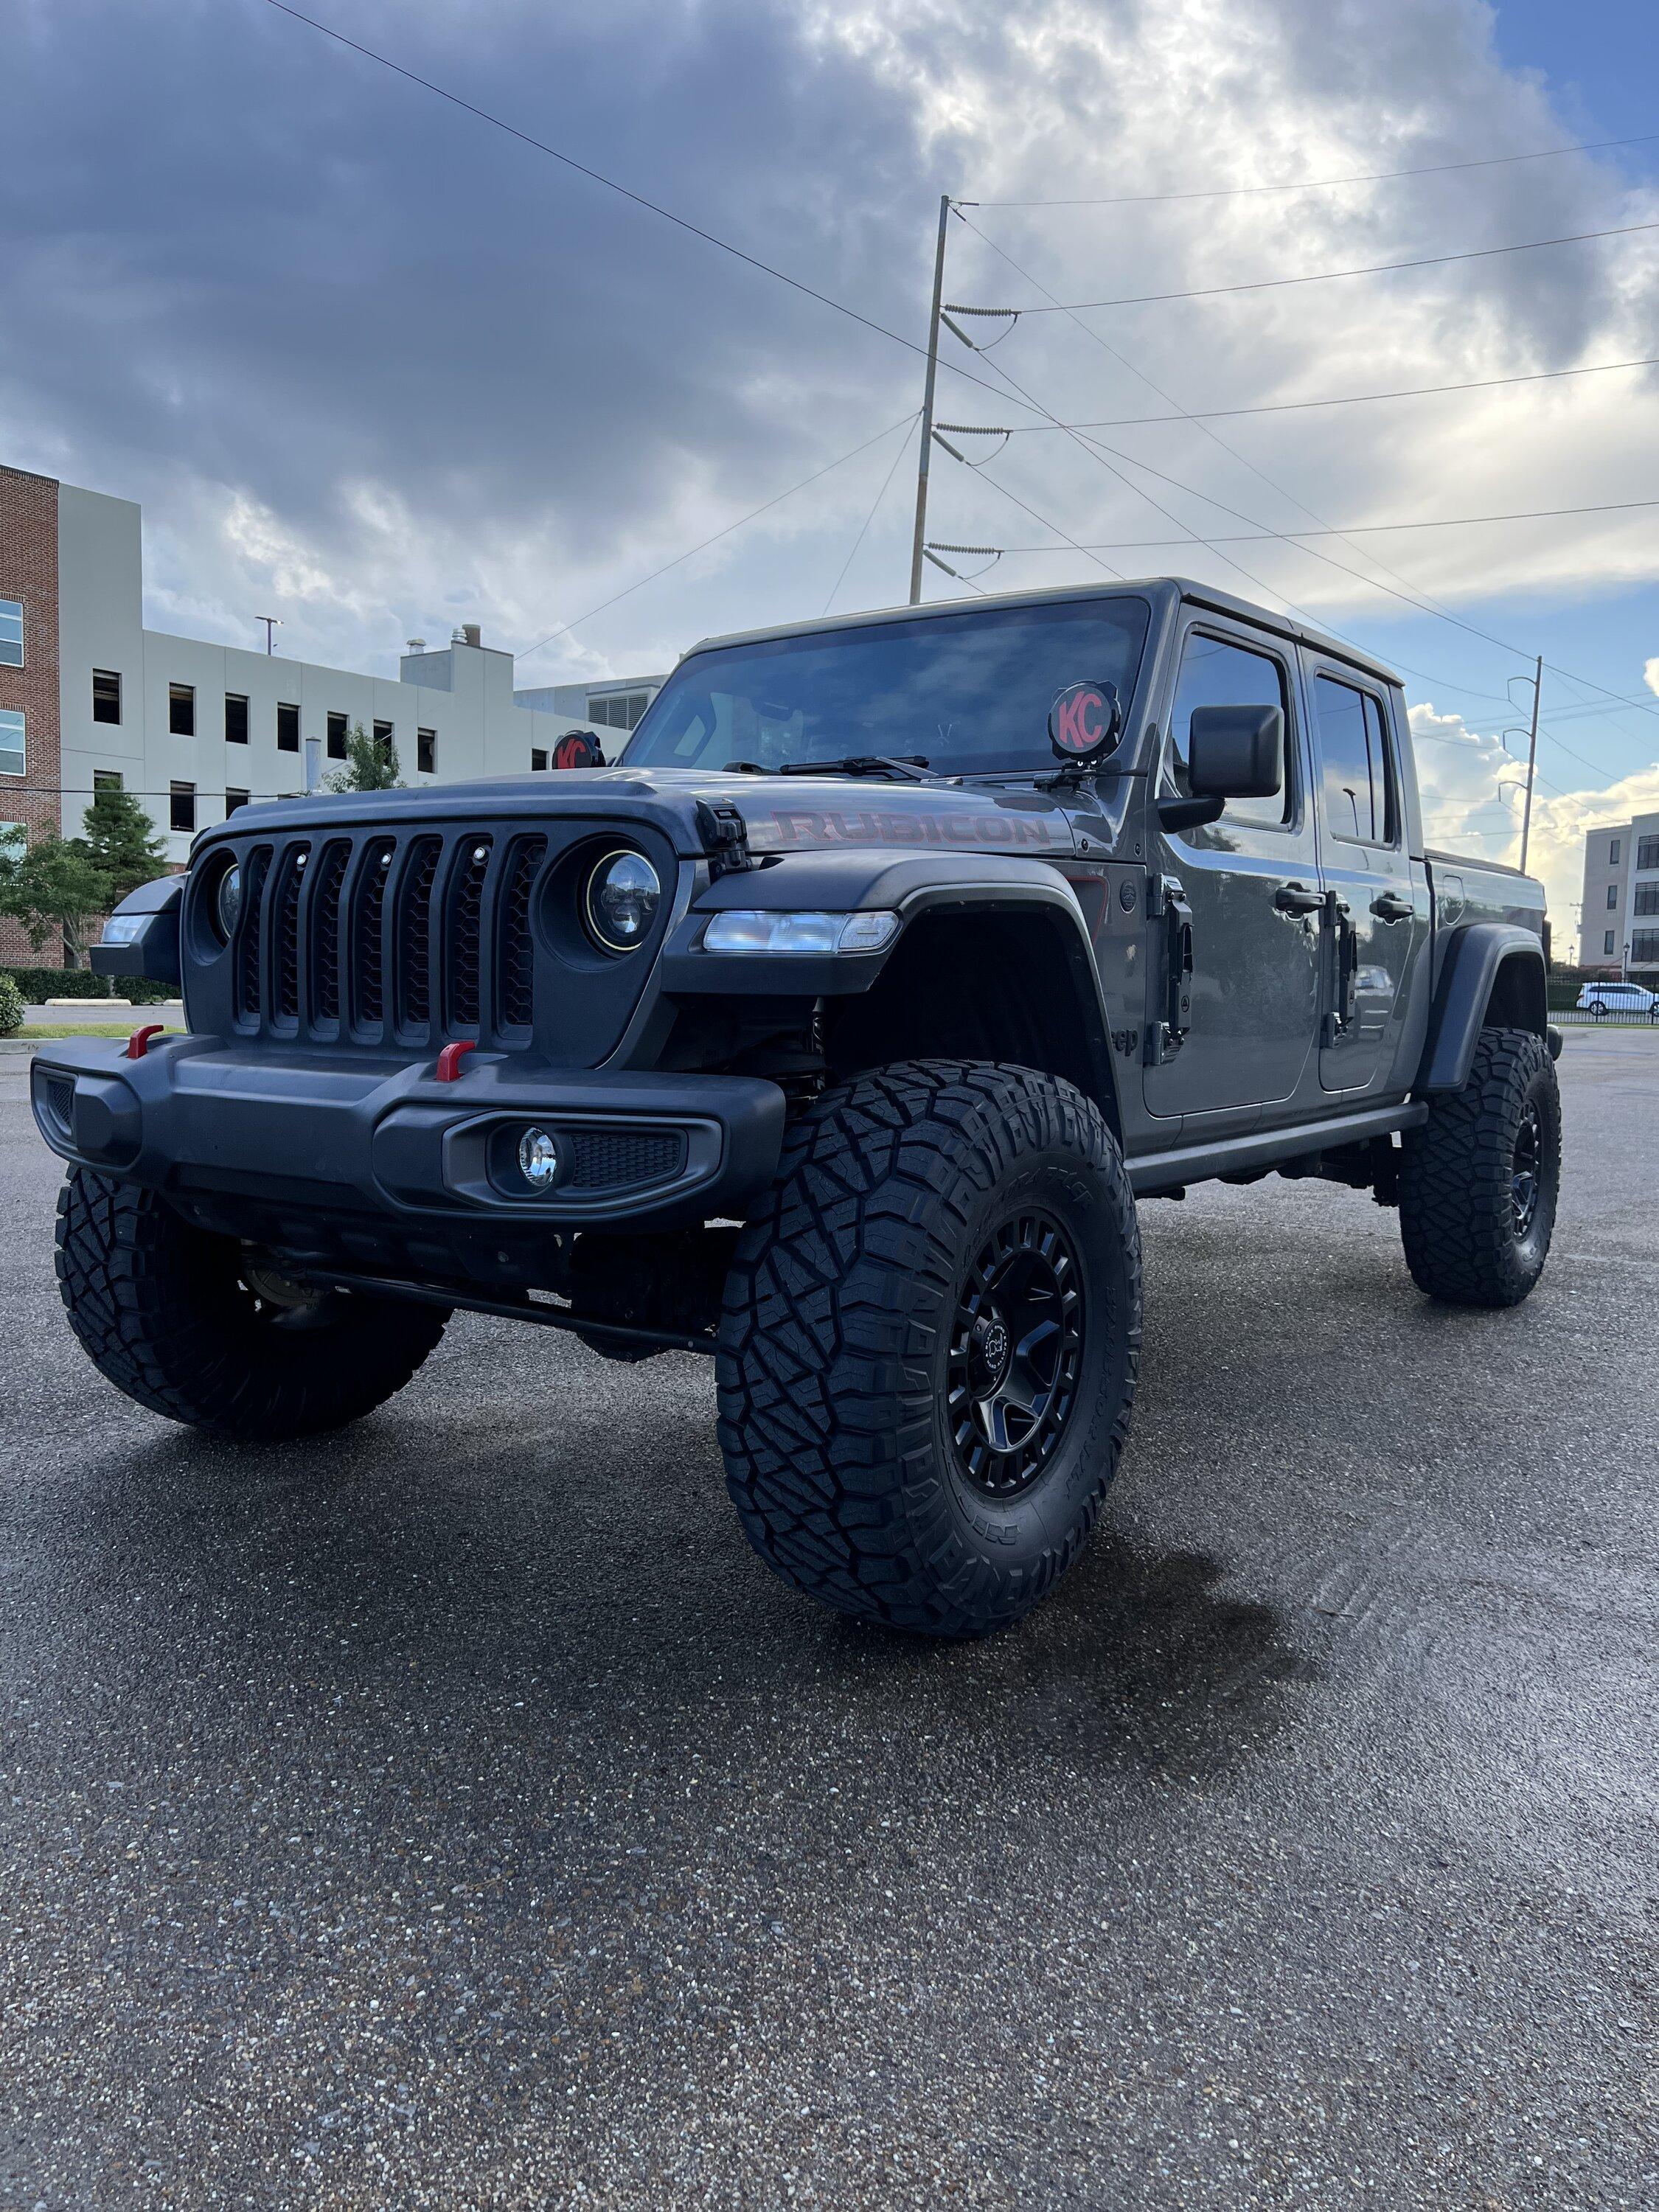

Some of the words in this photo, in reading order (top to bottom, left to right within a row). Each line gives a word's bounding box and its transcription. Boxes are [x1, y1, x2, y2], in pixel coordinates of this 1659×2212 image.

[1059, 691, 1102, 748] KC
[770, 810, 1051, 845] RUBICON
[1110, 1029, 1138, 1057] ep
